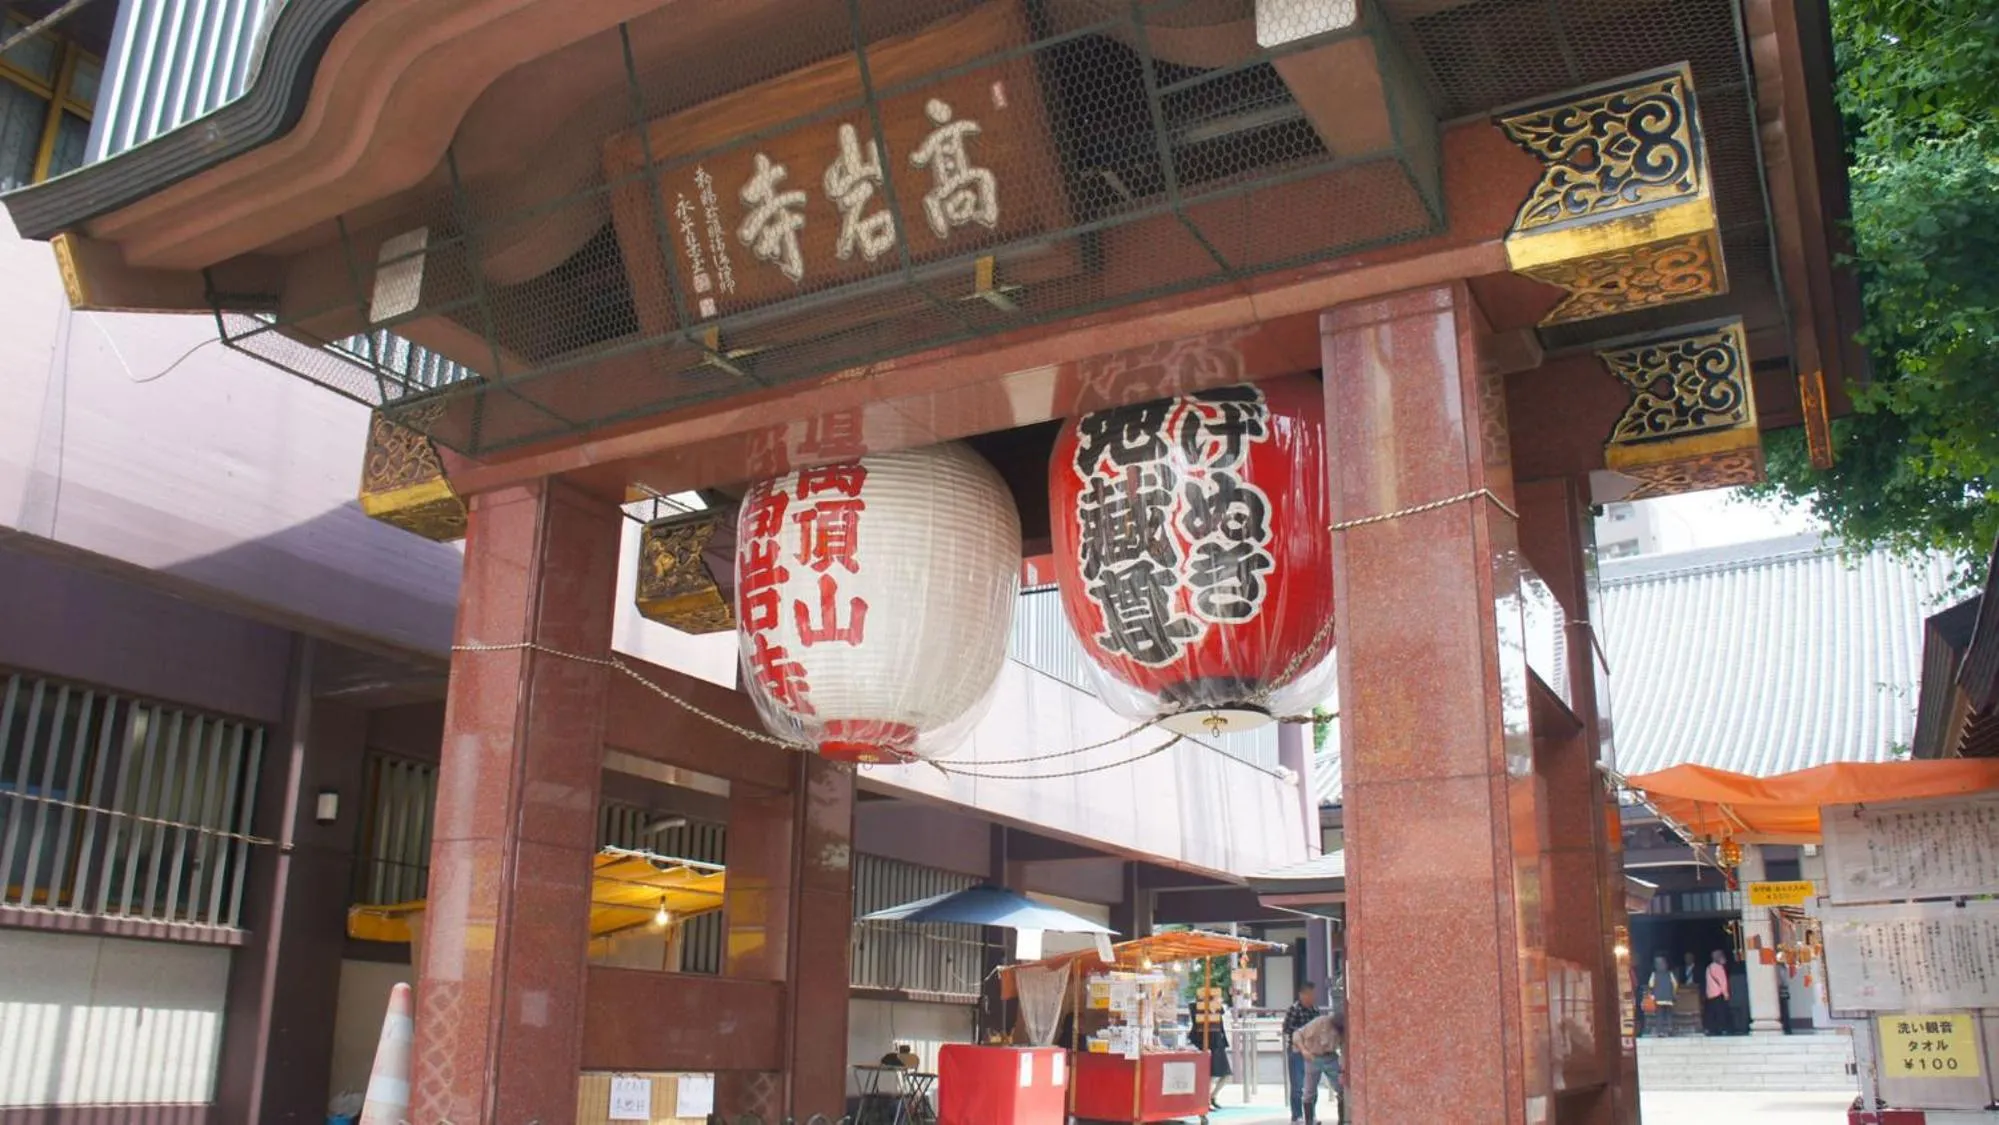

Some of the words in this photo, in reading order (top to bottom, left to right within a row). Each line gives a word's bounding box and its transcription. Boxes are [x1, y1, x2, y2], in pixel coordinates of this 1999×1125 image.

[1176, 384, 1276, 624] げぬき
[1897, 1021, 1953, 1034] 洗い観音
[1908, 1039, 1949, 1052] タオル
[1904, 1057, 1958, 1070] ¥100
